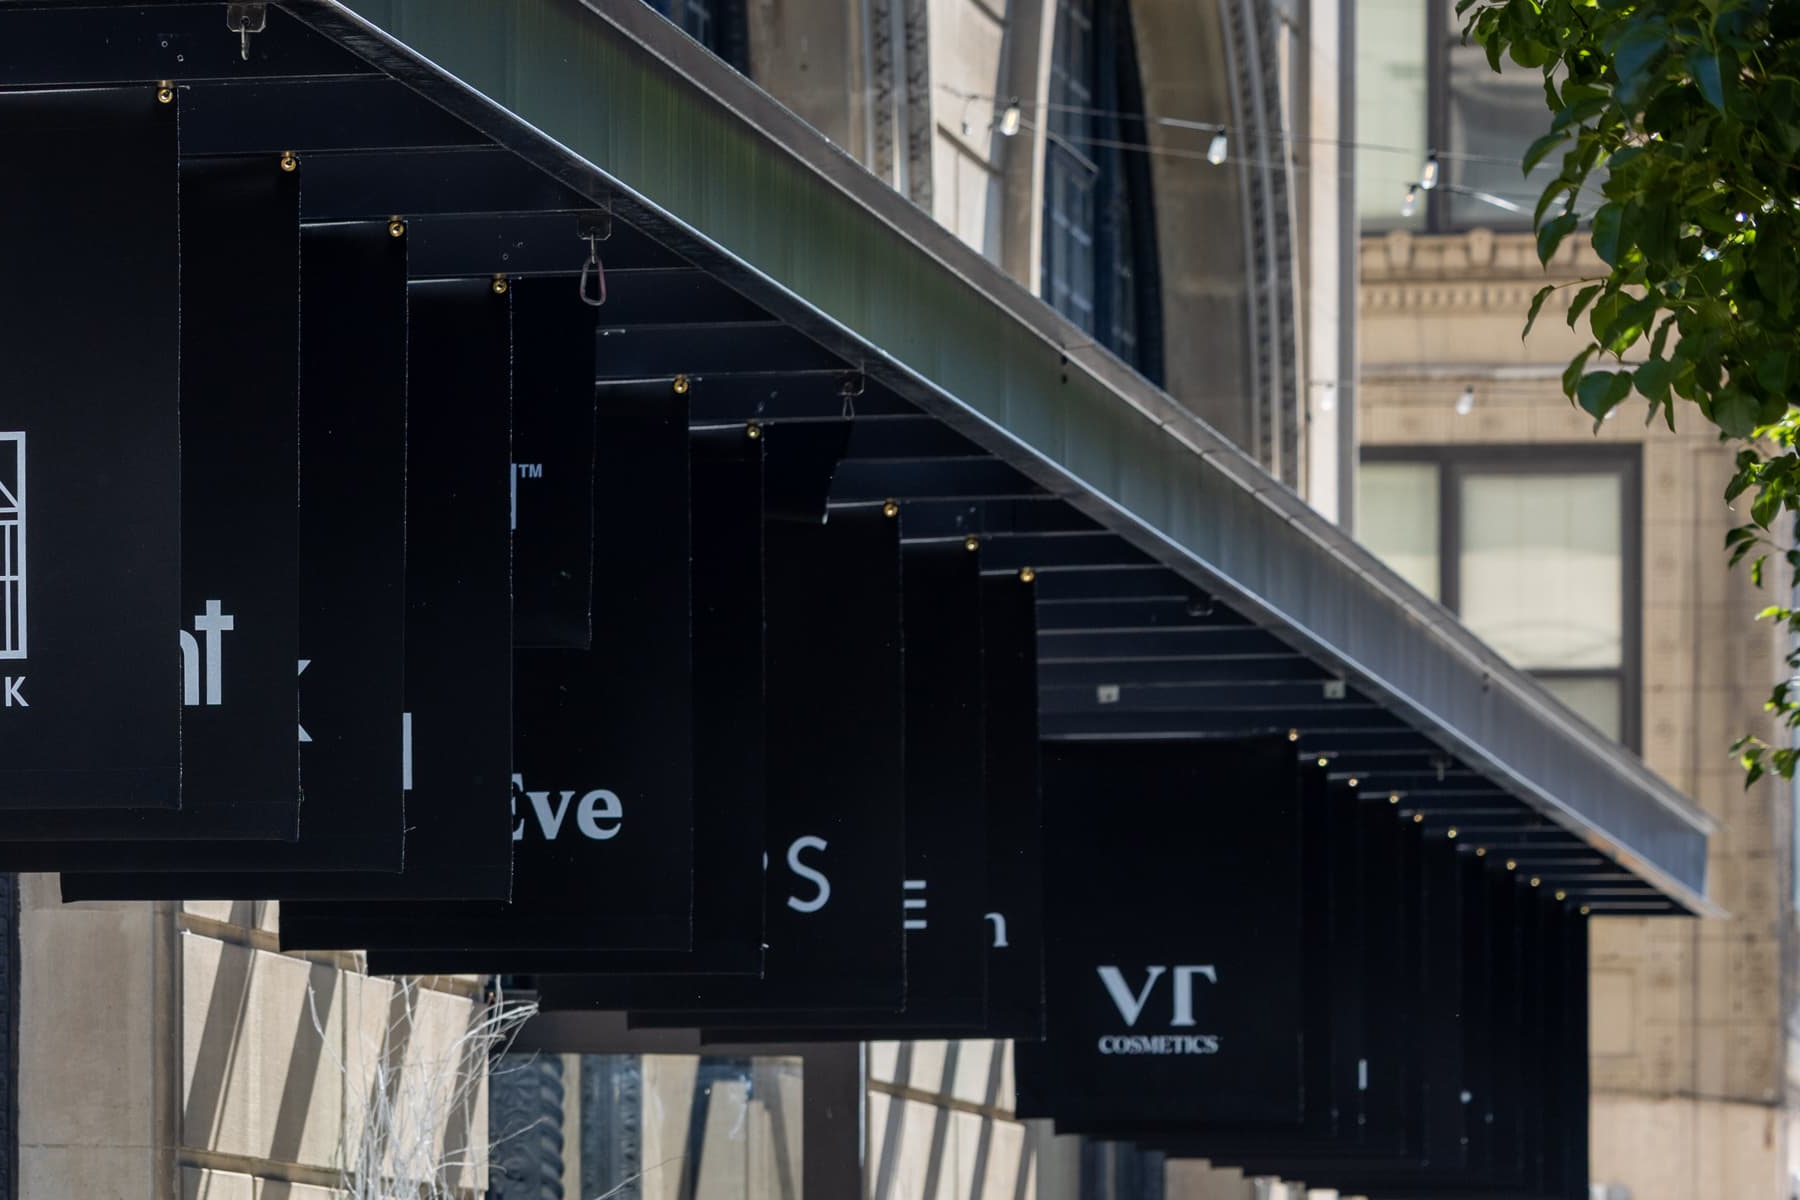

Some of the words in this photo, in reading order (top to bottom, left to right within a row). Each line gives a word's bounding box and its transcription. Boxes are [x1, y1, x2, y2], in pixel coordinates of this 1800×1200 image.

[4, 675, 30, 708] K
[1096, 965, 1218, 1027] VT
[1098, 1035, 1220, 1055] COSMETICS
